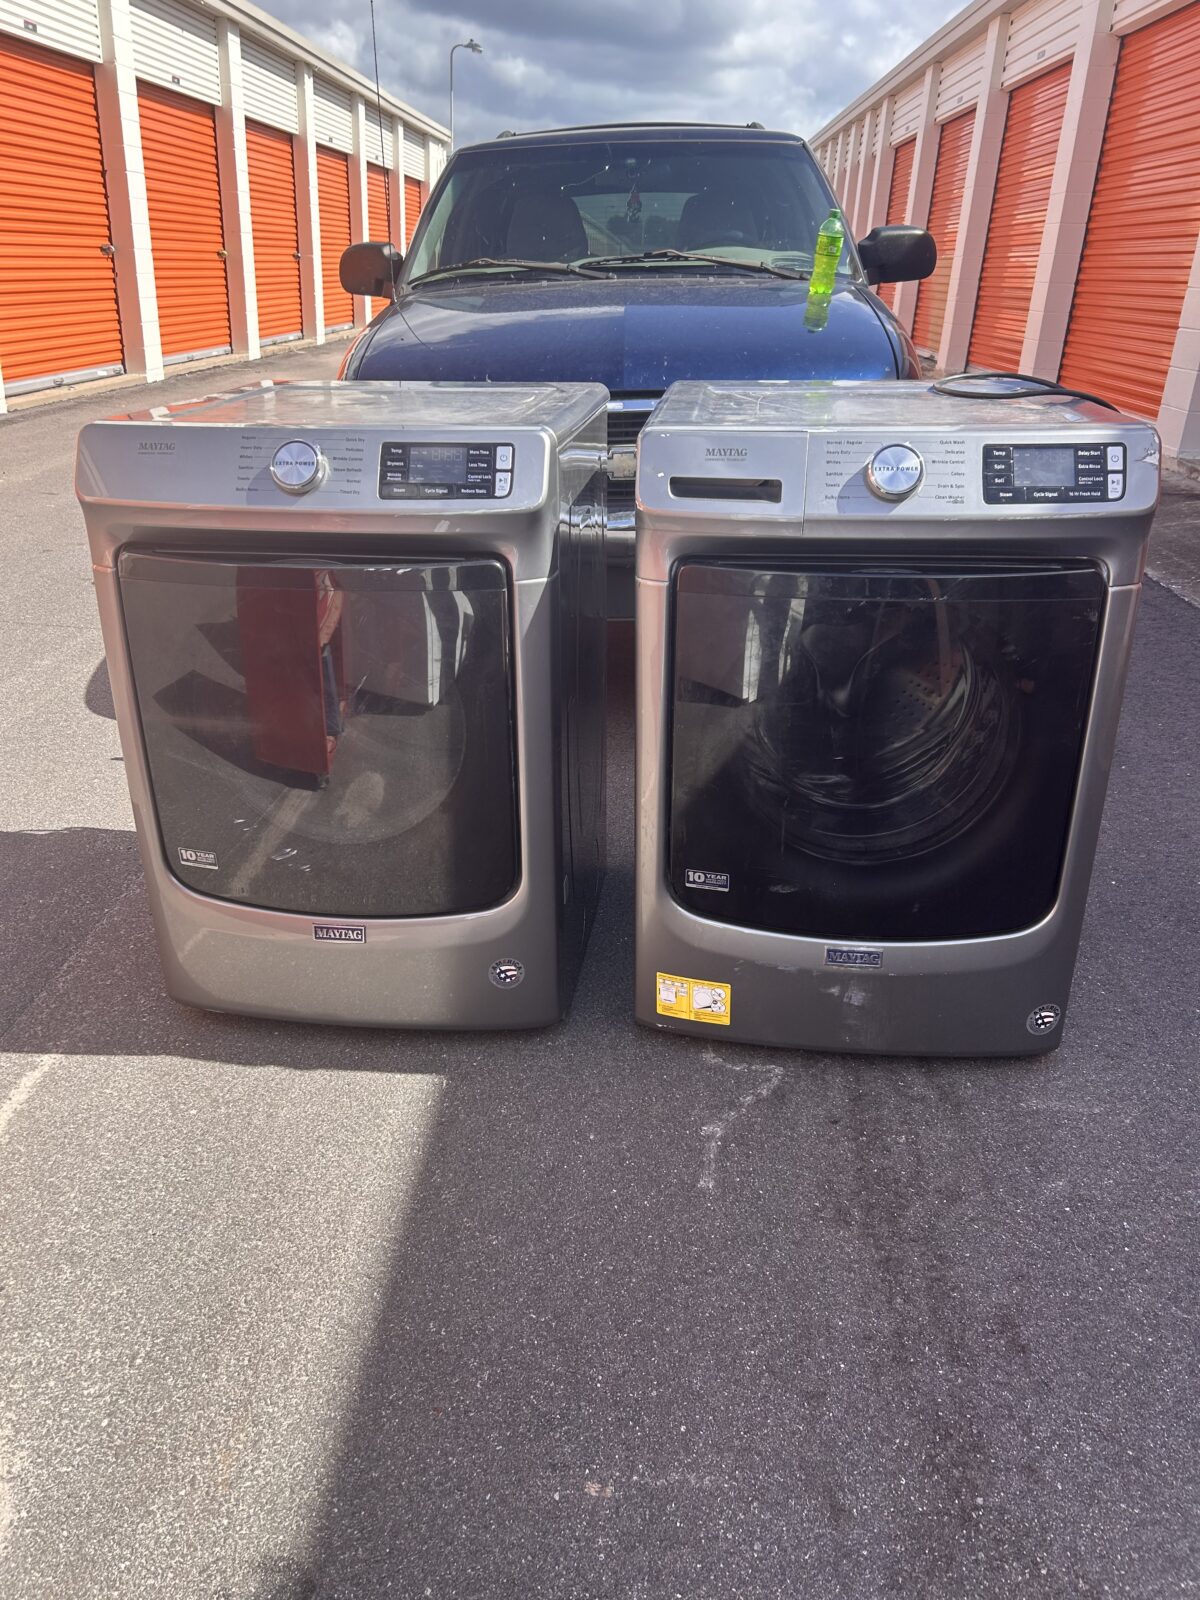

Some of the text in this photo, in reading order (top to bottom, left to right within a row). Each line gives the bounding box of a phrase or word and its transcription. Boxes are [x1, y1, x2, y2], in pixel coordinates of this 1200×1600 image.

[138, 442, 176, 450] MAYTAG
[705, 448, 748, 457] MAYTAG
[180, 850, 196, 860] 10
[688, 871, 705, 882] 10
[316, 928, 362, 940] MAYTAG
[828, 952, 879, 964] MAYTAG
